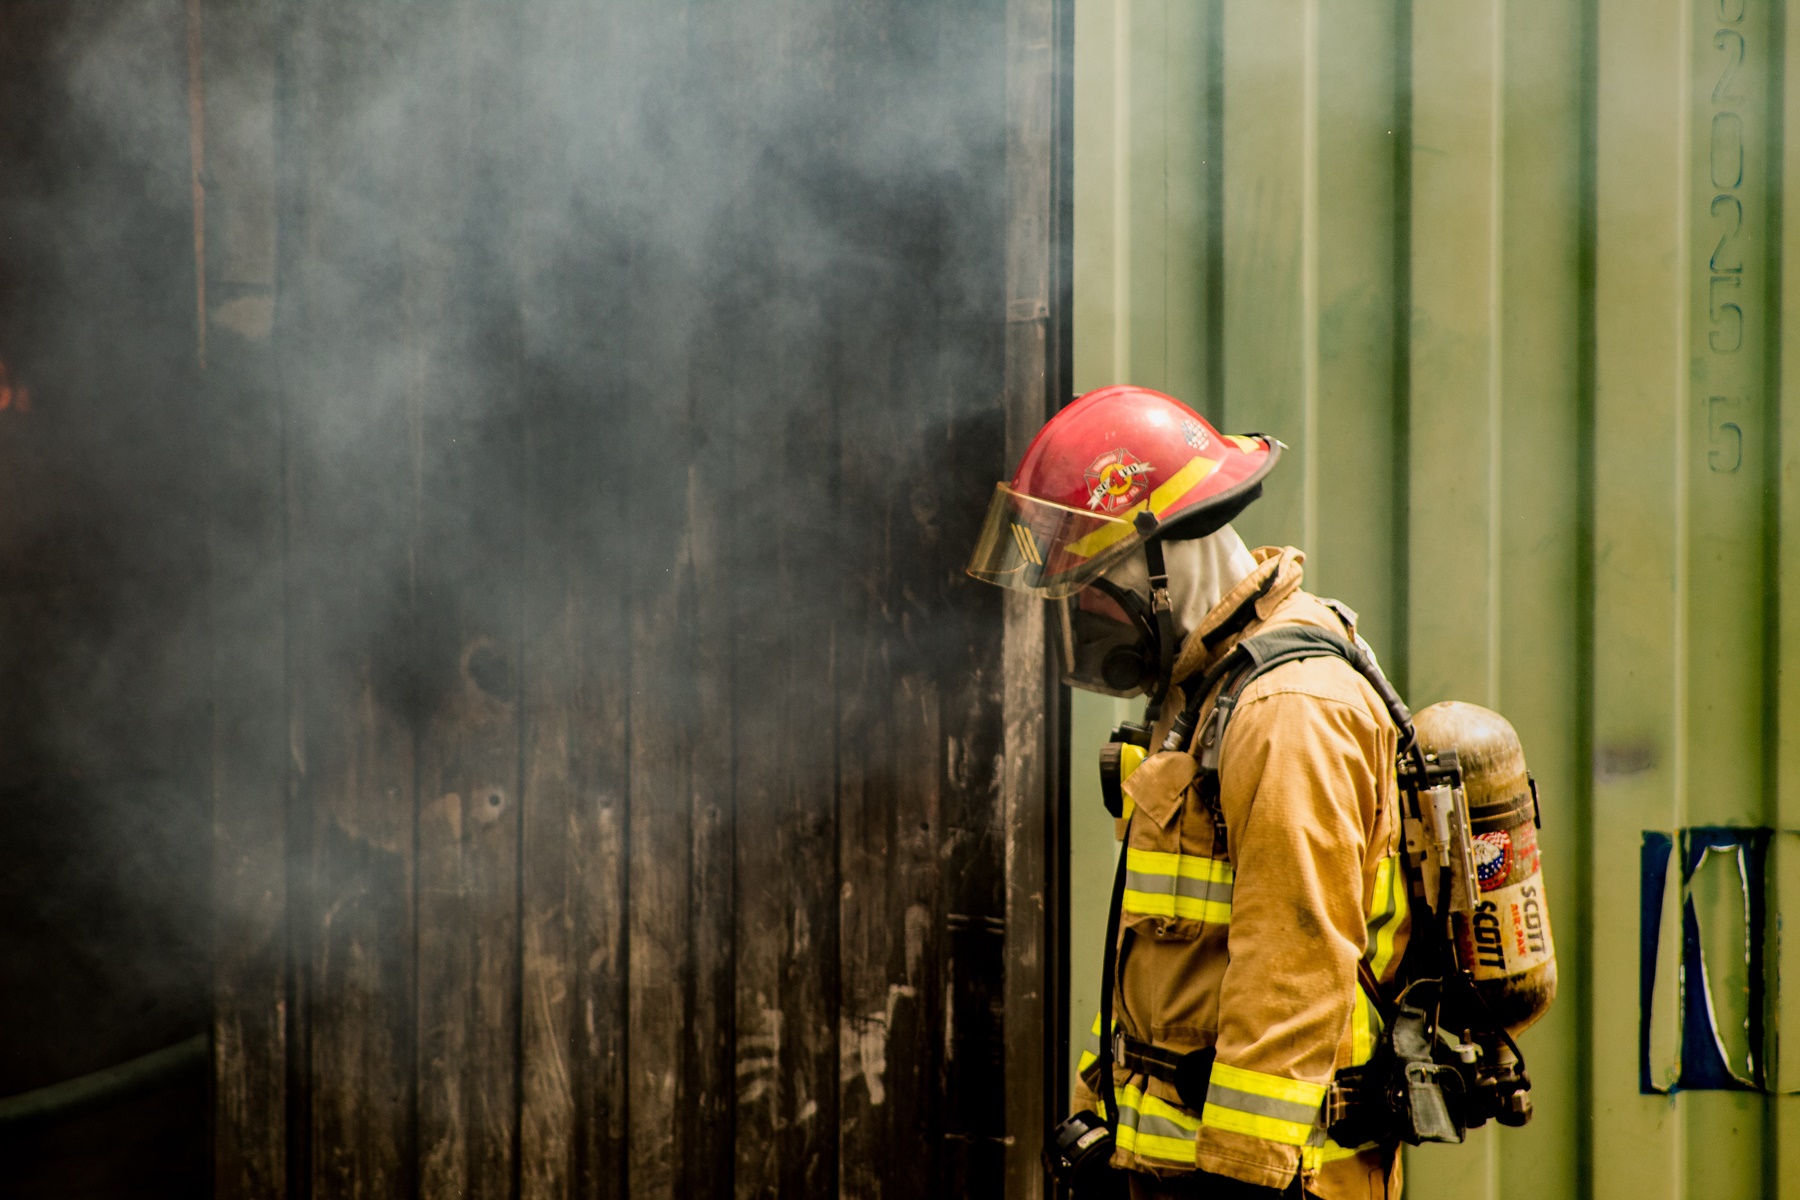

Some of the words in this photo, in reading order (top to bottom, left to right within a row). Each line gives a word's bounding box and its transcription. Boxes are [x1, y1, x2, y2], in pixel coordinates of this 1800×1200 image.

[1707, 395, 1743, 474] 5
[1472, 900, 1506, 970] SCOTT
[1510, 903, 1527, 957] AIR-PAK
[1521, 885, 1546, 954] SCOTT
